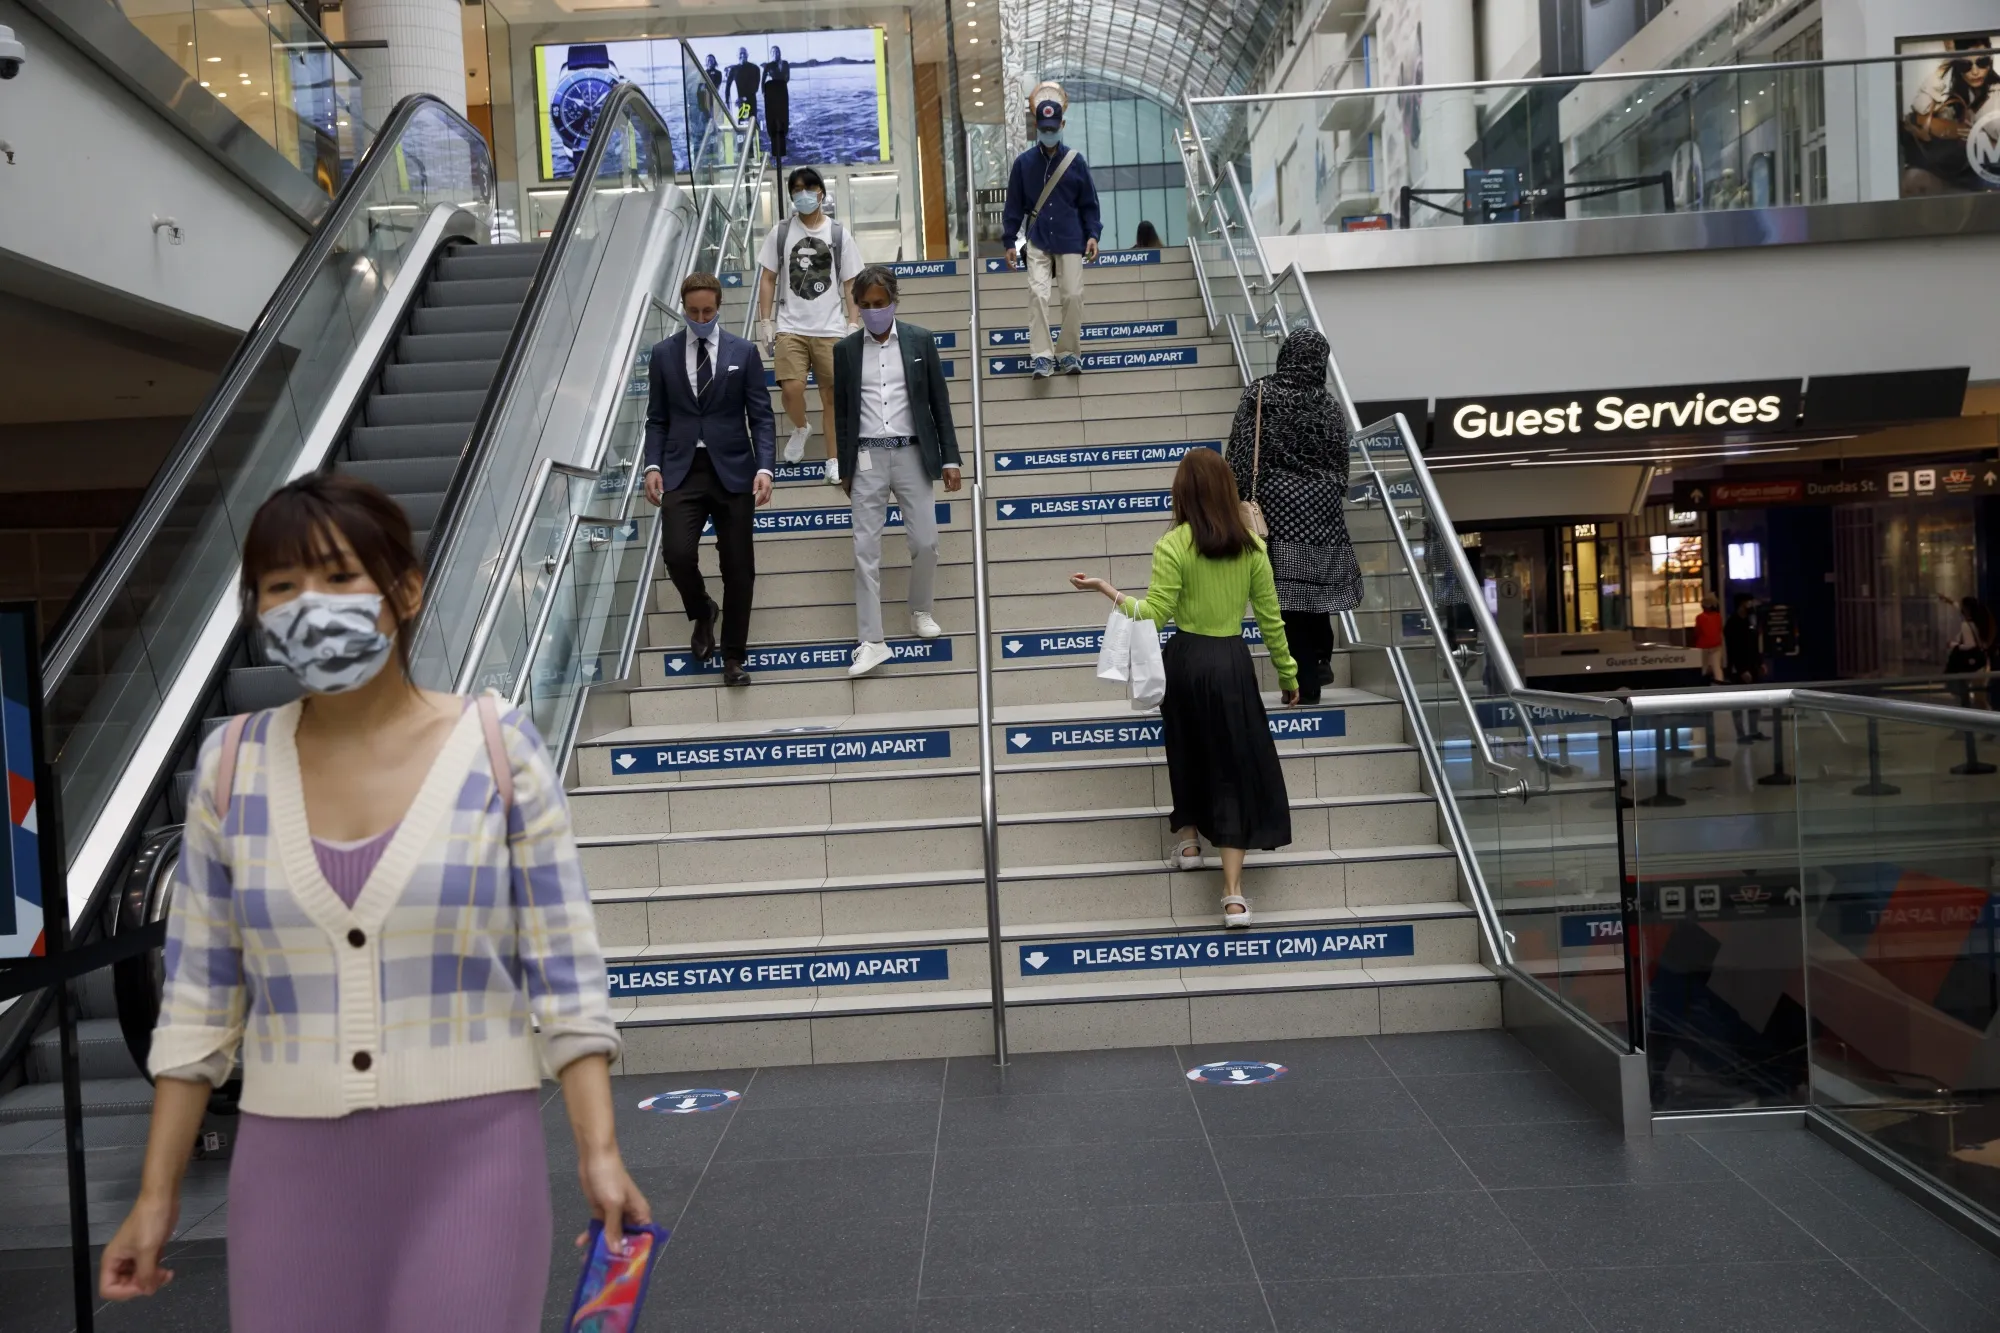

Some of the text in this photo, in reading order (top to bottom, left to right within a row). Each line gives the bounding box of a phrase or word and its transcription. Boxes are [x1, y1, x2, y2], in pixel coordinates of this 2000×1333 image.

[1099, 254, 1118, 265] (2M)
[1120, 253, 1149, 263] APART
[894, 264, 945, 276] (2M) APART
[1086, 327, 1108, 337] FEET
[1111, 325, 1132, 338] (2M)
[1133, 324, 1165, 335] APART
[1088, 357, 1095, 366] 6
[1097, 355, 1122, 365] FEET
[1124, 353, 1147, 366] (2M)
[1148, 351, 1184, 363] APART
[1453, 392, 1781, 439] Guest Services
[1025, 453, 1067, 466] PLEASE
[1069, 451, 1101, 463] STAY
[1102, 450, 1109, 462] 6
[1112, 449, 1140, 461] FEET
[1142, 448, 1166, 461] (2M)
[803, 466, 825, 476] STA
[1807, 479, 1878, 495] Dundas St.
[1031, 499, 1079, 513] PLEASE
[1081, 498, 1116, 511] STAY
[1118, 497, 1126, 509] 6
[1129, 495, 1161, 508] FEET
[778, 515, 812, 527] STAY
[814, 514, 823, 525] 6
[1040, 635, 1093, 651] PLEASE
[759, 652, 797, 666] STAY
[800, 651, 809, 663] 6
[813, 650, 847, 663] FEET
[1605, 653, 1686, 669] Guest Services
[1052, 718, 1322, 745] PLEASE STAY APART
[657, 738, 927, 766] PLEASE STAY 6 FEET (2M) APART
[1073, 933, 1388, 966] PLEASE STAY 6 FEET (2M) APART
[607, 958, 921, 990] PLEASE STAY 6 FEET (2M) APART
